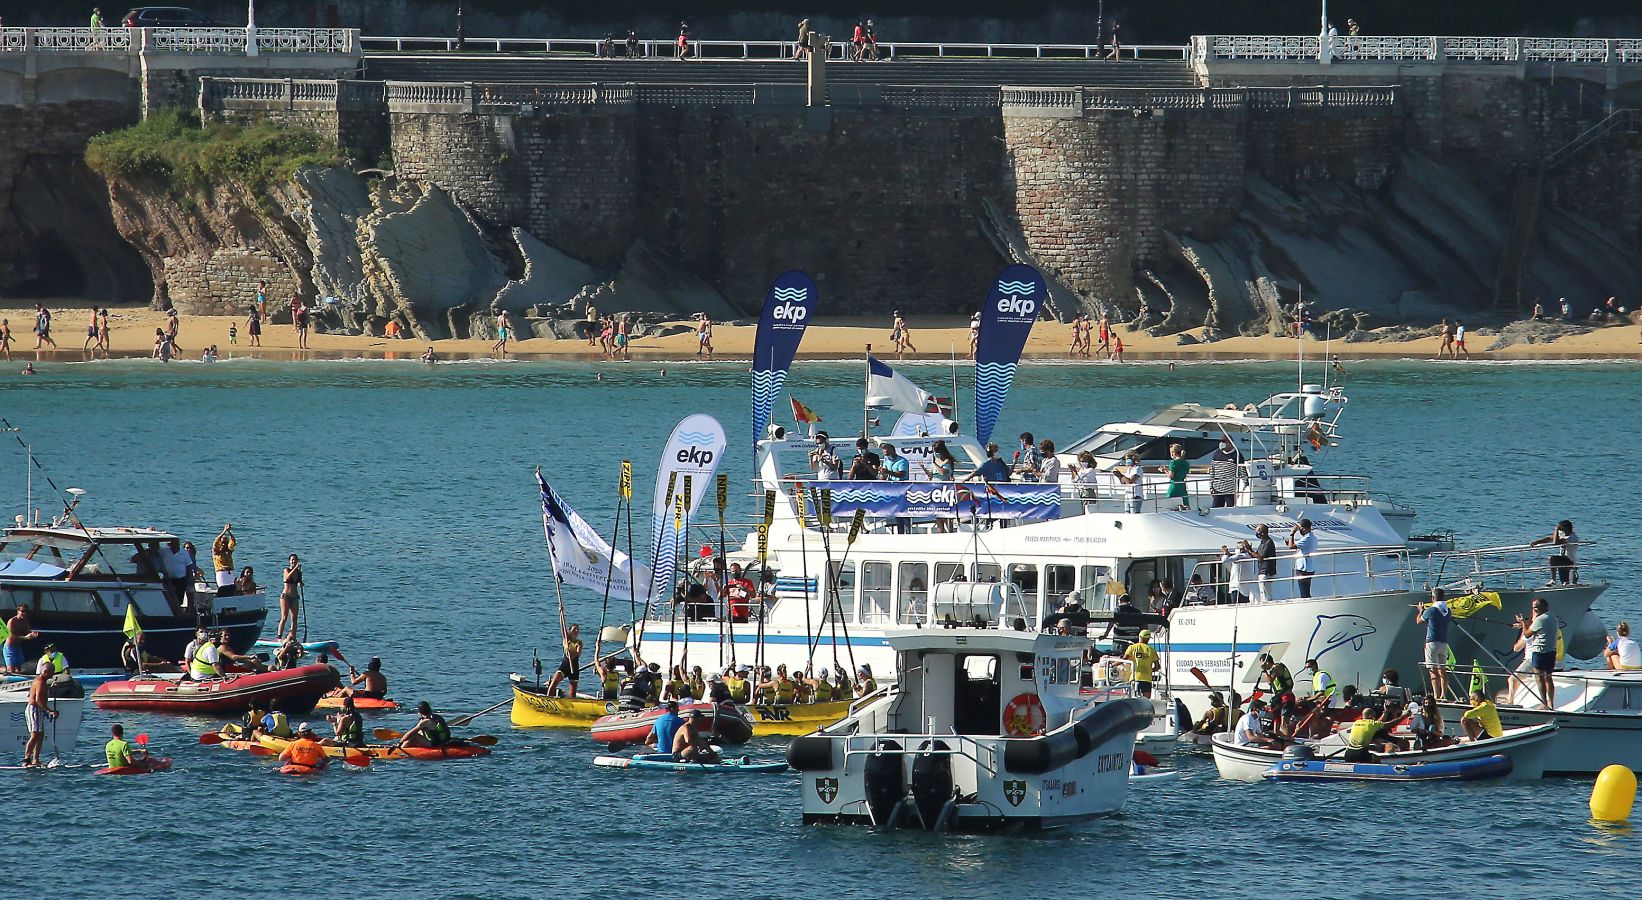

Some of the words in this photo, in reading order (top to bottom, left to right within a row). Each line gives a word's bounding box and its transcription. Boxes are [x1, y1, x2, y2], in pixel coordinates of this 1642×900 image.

[773, 301, 807, 323] ekp
[998, 295, 1034, 316] ekp
[677, 446, 713, 467] ekp
[932, 485, 956, 506] ekp
[587, 565, 603, 574] 2020
